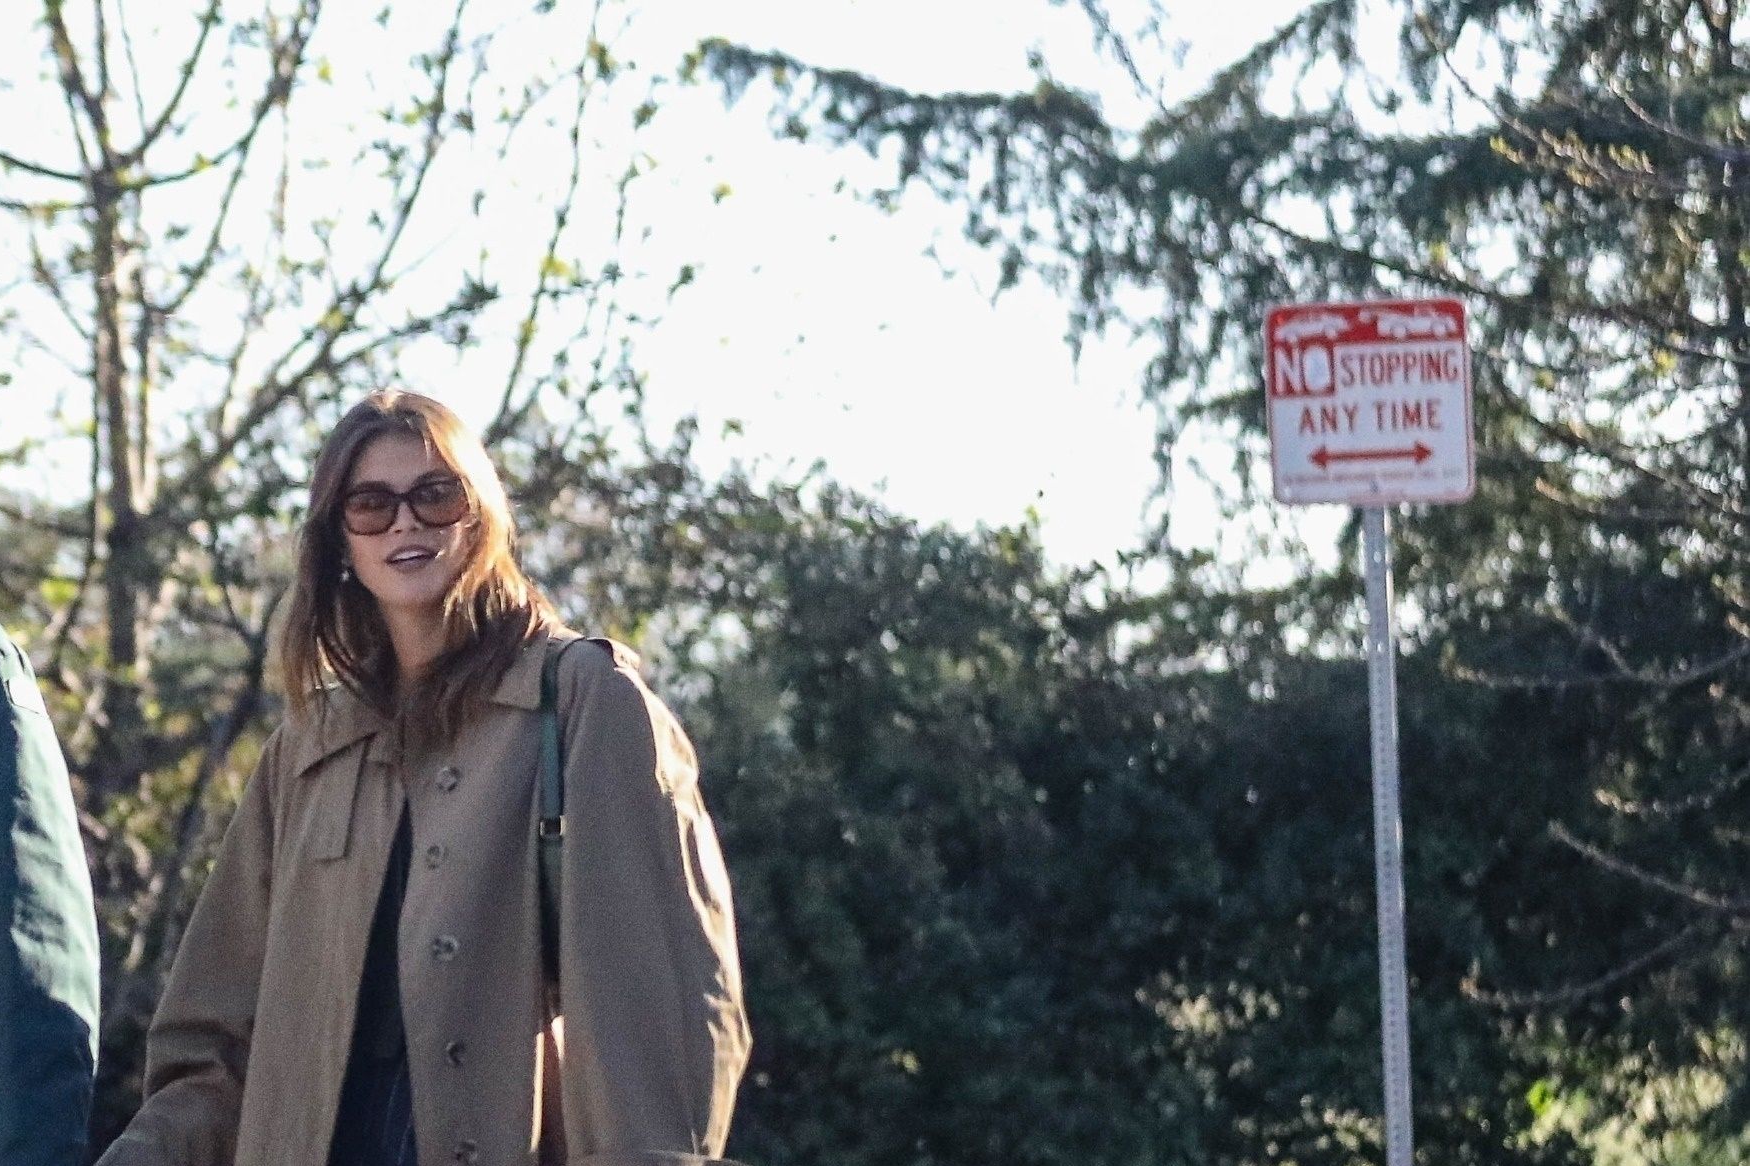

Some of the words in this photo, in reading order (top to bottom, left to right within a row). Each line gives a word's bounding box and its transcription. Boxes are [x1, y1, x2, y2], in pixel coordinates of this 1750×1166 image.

[1273, 346, 1332, 394] NO
[1340, 349, 1459, 388] STOPPING
[1298, 402, 1359, 436] ANY
[1372, 399, 1443, 433] TIME
